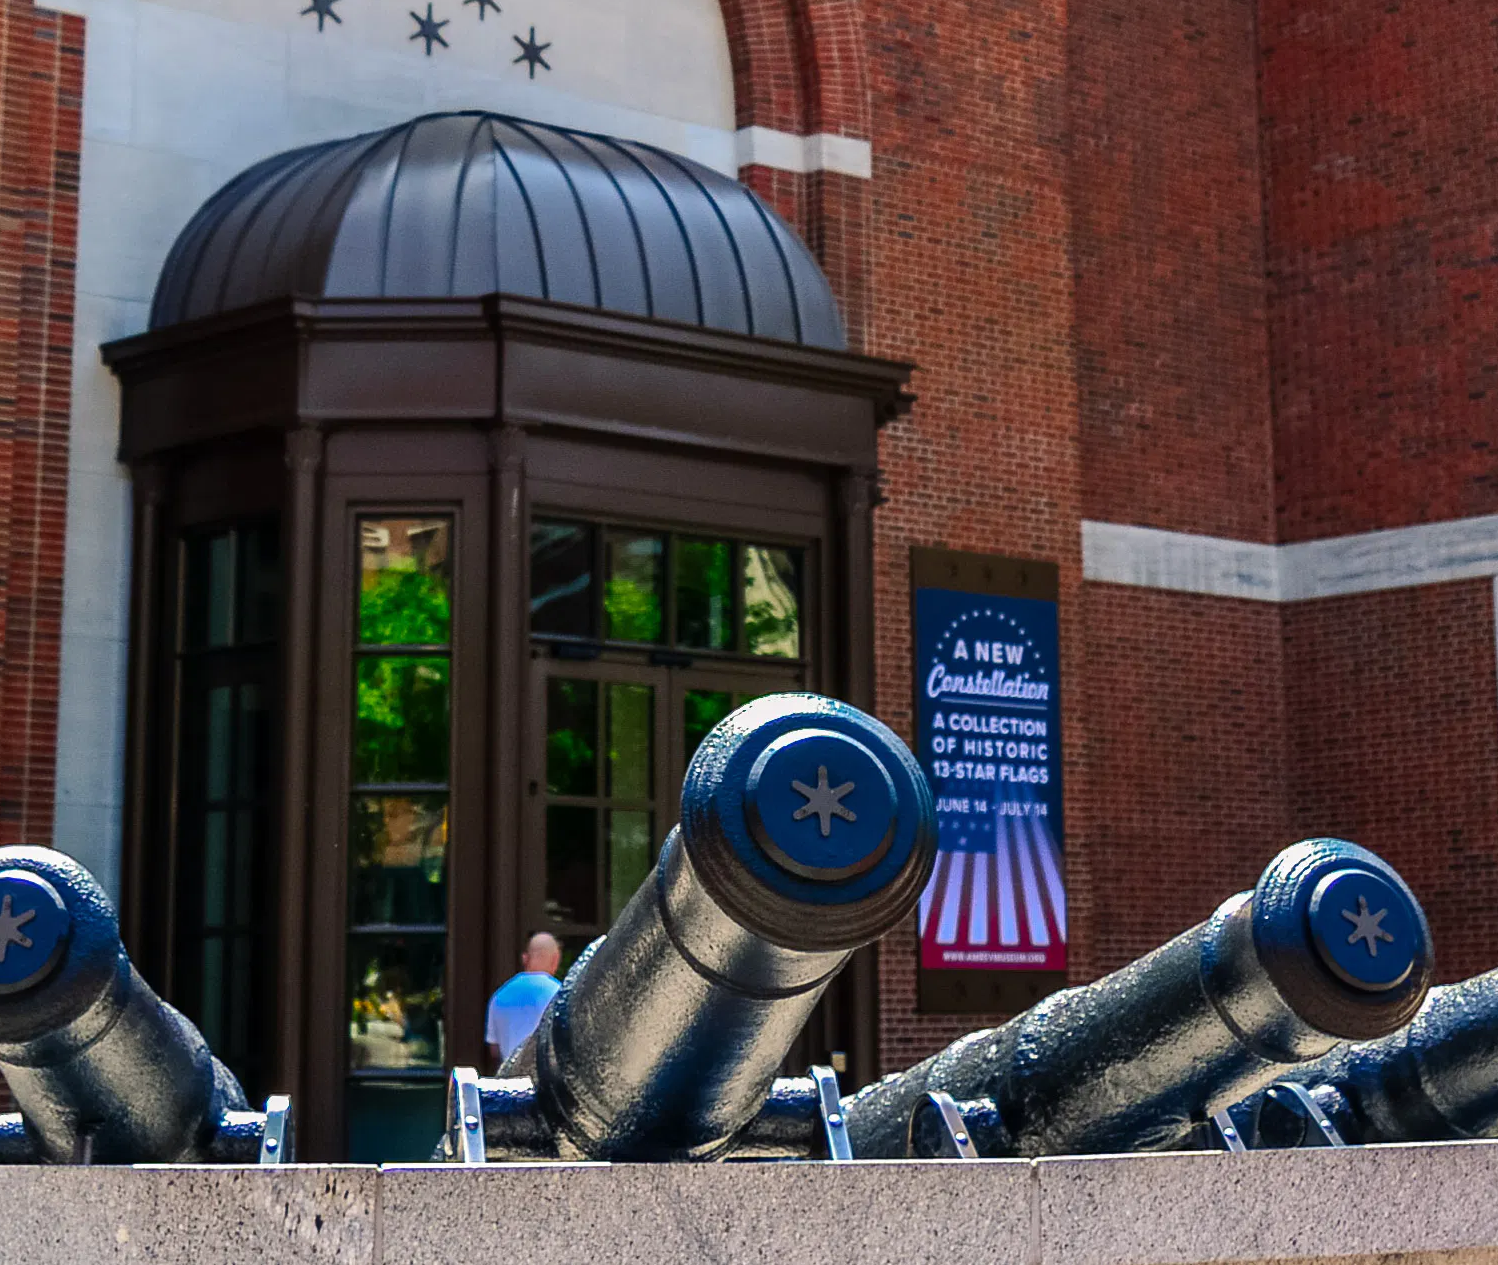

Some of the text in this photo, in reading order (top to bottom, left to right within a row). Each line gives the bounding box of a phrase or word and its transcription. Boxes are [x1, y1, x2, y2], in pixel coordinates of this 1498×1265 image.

[953, 638, 1025, 666] A NEW
[926, 662, 1050, 701] Constellation
[932, 711, 1048, 737] A COLLECTION
[932, 735, 1049, 761] OF HISTORIC
[932, 759, 1050, 785] 13-STAR FLAGS
[935, 797, 971, 814] JUNE
[973, 799, 988, 814] 14
[999, 801, 1032, 817] JULY
[1033, 802, 1049, 817] 14
